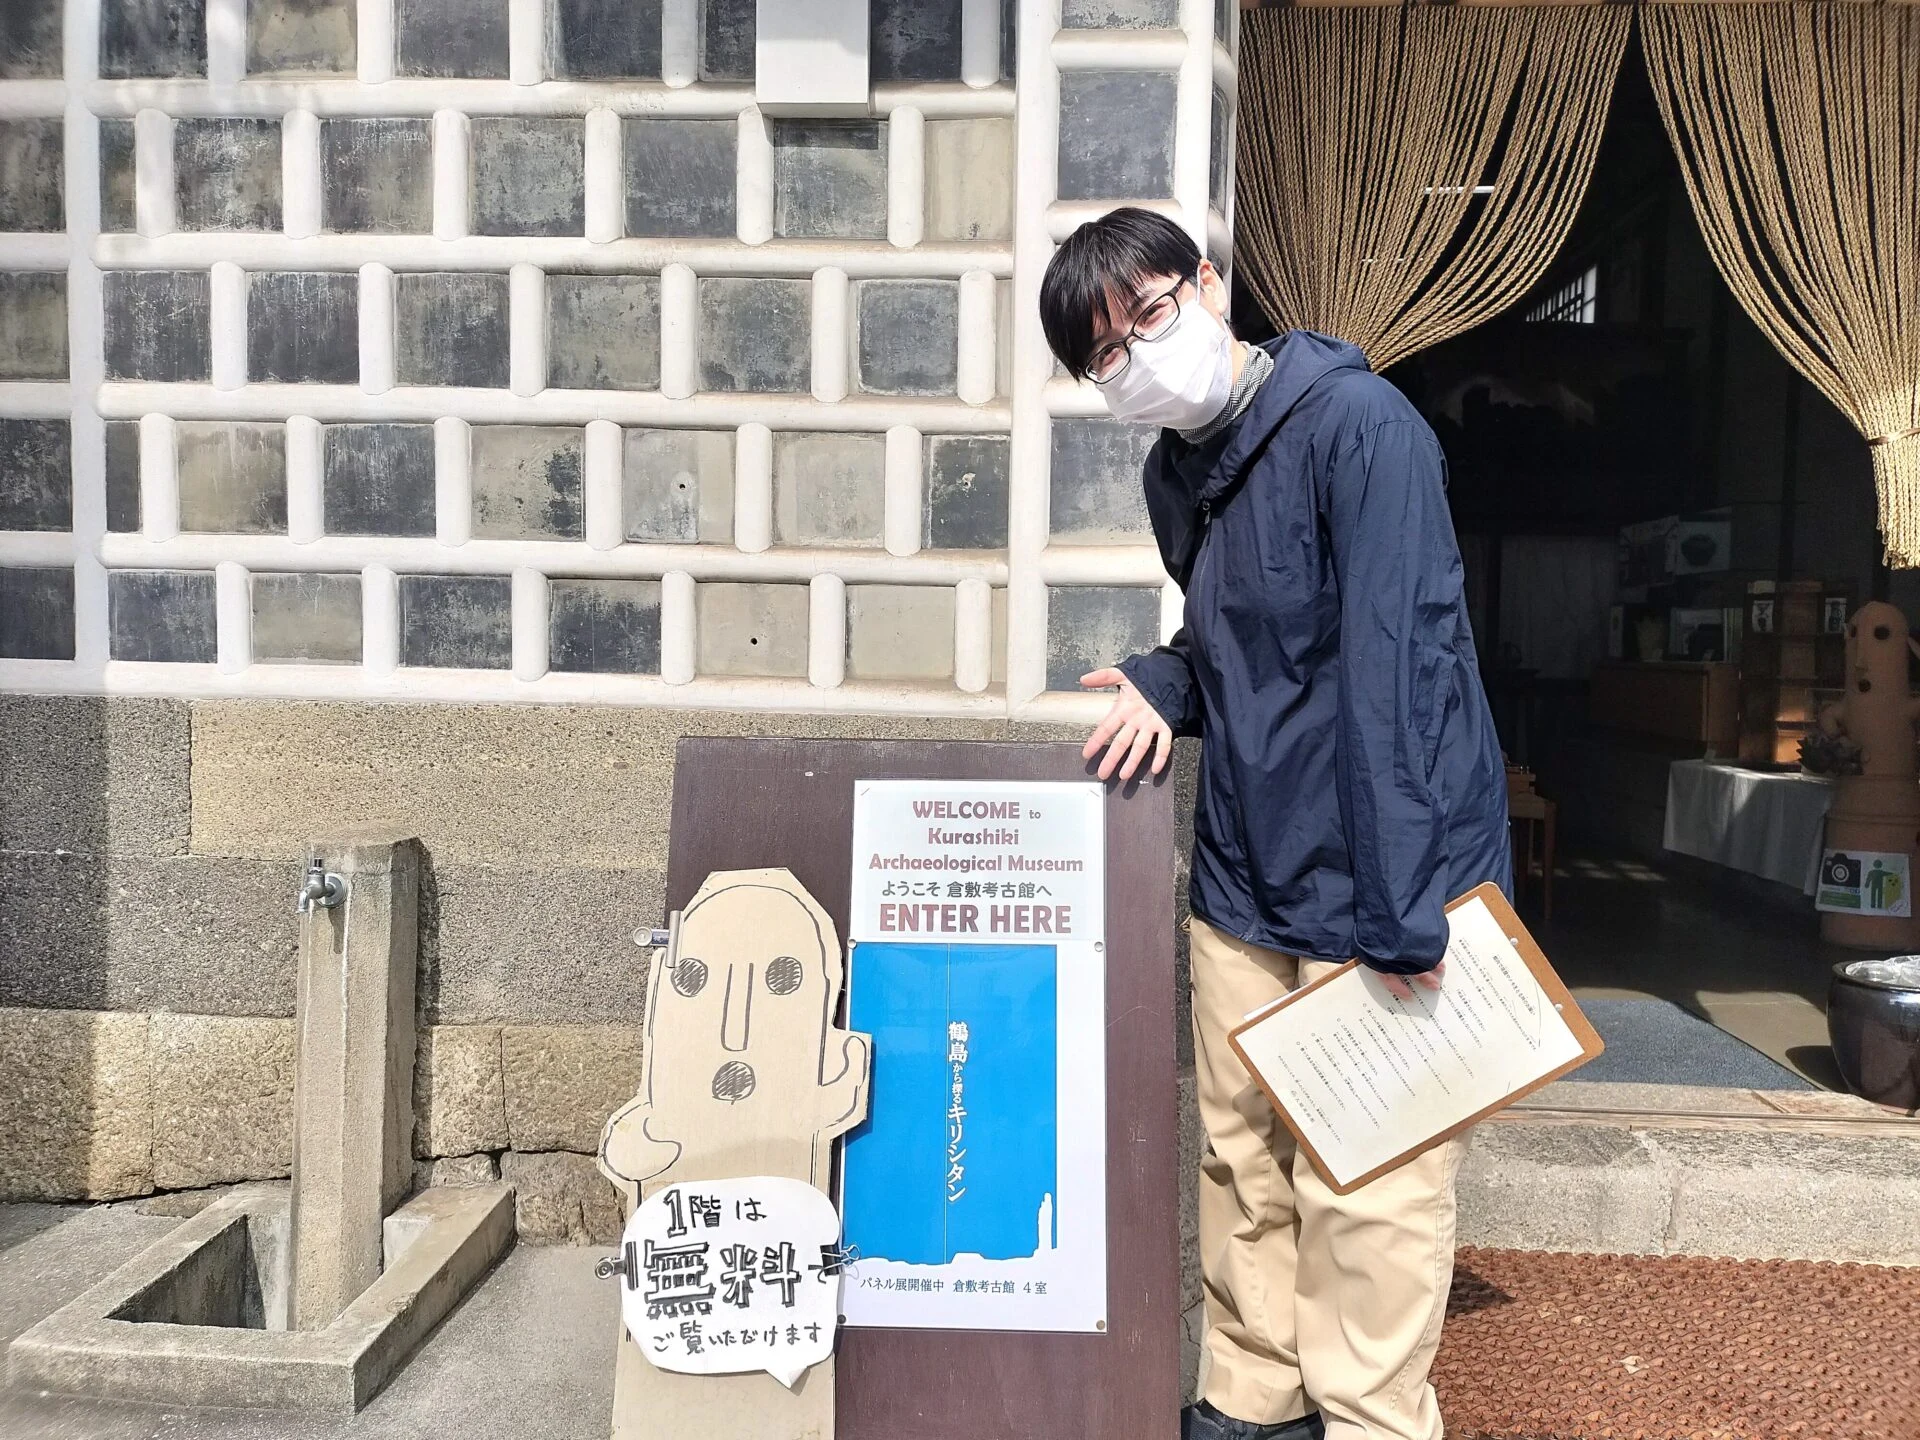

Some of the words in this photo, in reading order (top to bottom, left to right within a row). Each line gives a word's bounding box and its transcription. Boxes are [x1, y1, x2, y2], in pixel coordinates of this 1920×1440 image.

[912, 800, 1020, 819] WELCOME
[1029, 809, 1041, 819] to
[928, 827, 1019, 845] Kurashiki
[869, 853, 1002, 873] Archaeological
[1008, 855, 1083, 872] Museum
[882, 880, 941, 897] ようこそ
[946, 881, 1053, 898] 倉敷考古館へ
[880, 904, 979, 933] ENTER
[990, 905, 1072, 934] HERE
[947, 1021, 969, 1202] 鶴島から探るキリシタン
[663, 1189, 767, 1238] 1階は
[860, 1278, 944, 1293] パネル展開催中
[953, 1279, 1015, 1294] 倉敷考古館
[653, 1320, 822, 1355] ご覧いただけます
